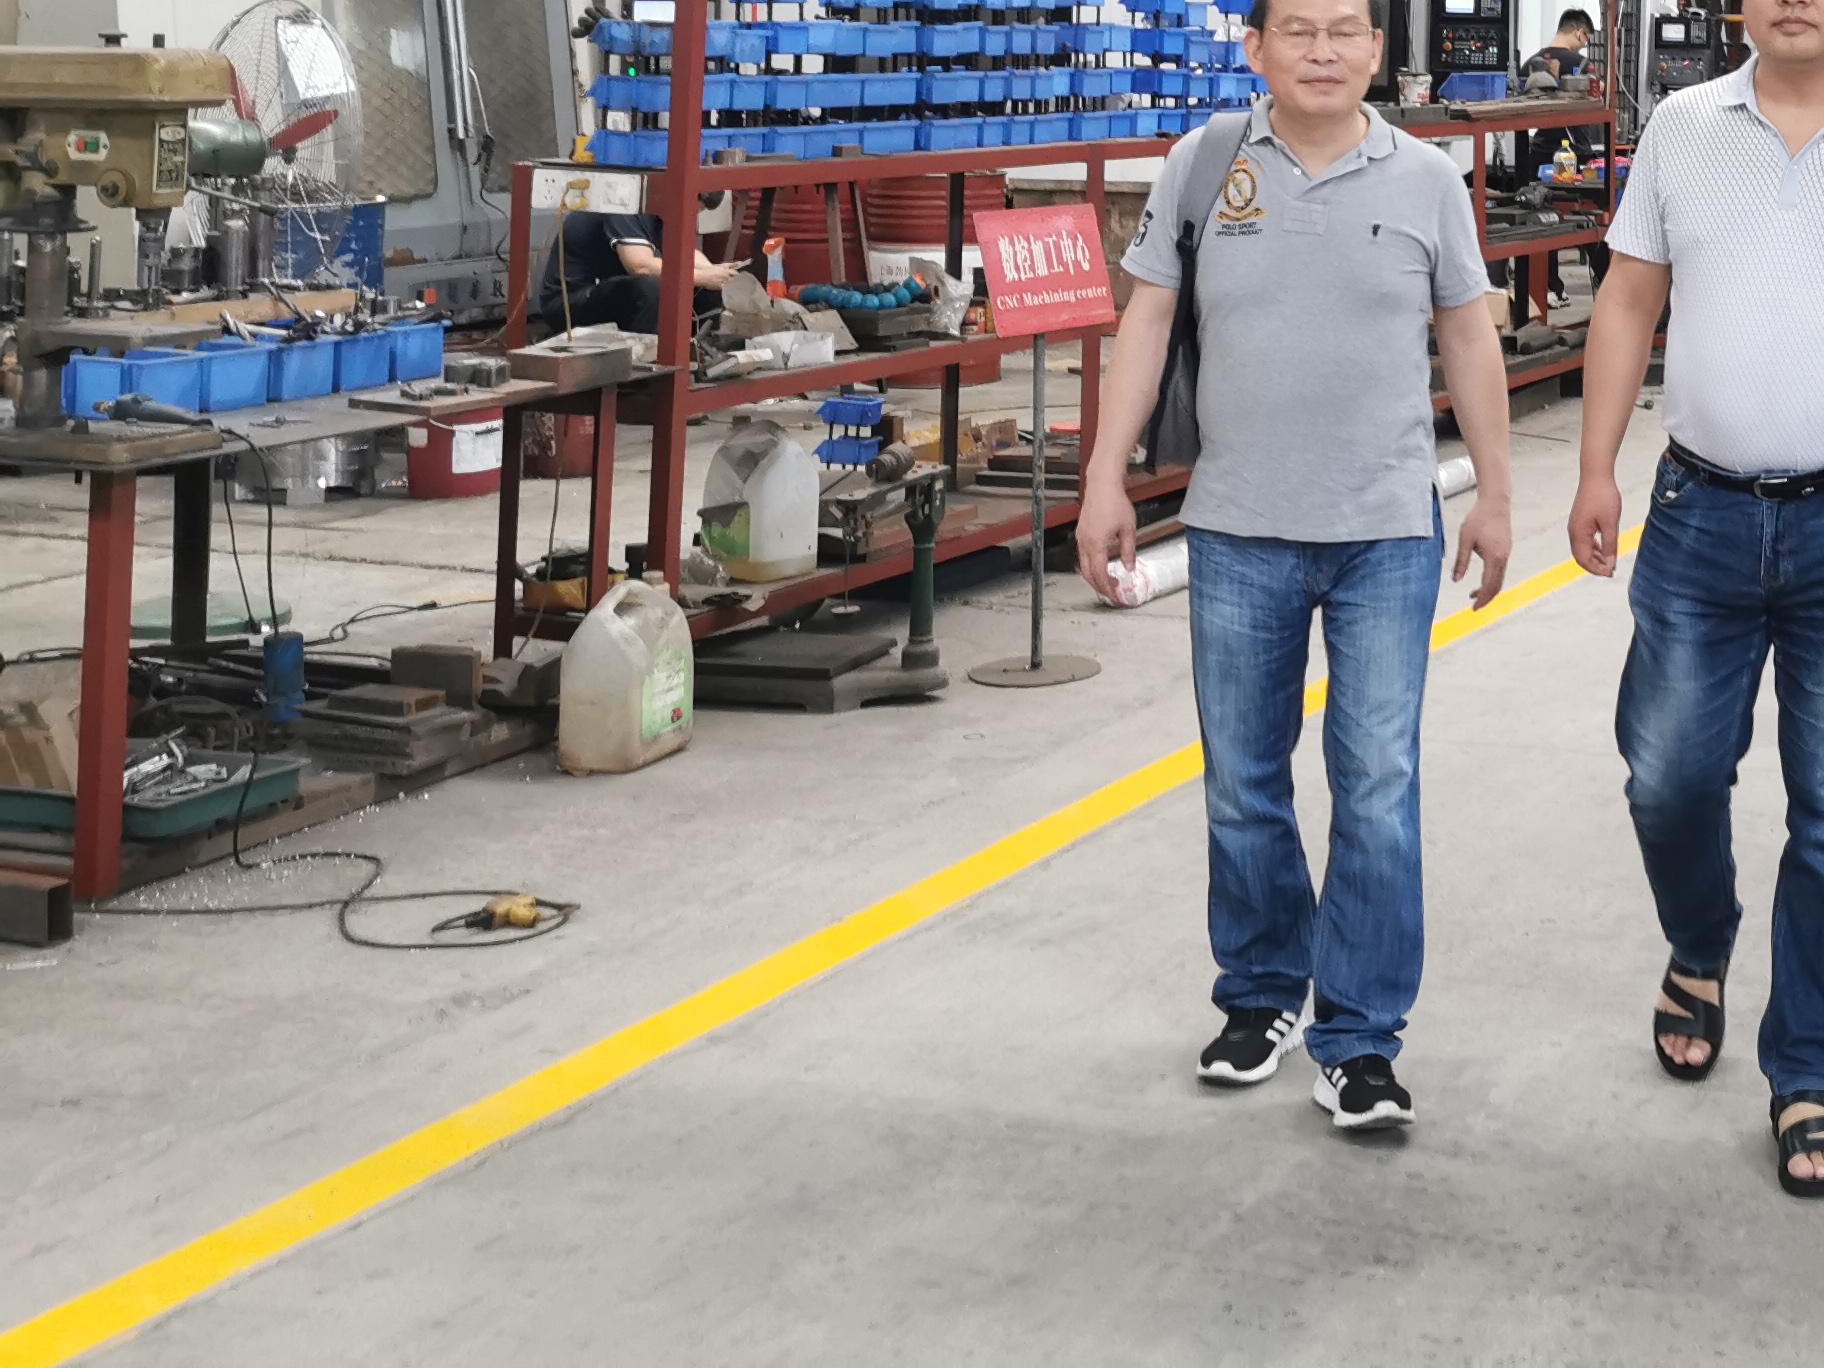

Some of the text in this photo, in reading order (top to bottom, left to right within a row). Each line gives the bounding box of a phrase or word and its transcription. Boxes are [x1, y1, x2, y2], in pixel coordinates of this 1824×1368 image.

[1221, 221, 1257, 231] POLO SPORT
[1238, 228, 1263, 236] PRODUCT
[998, 229, 1091, 284] 数控加工中心
[996, 285, 1109, 311] CNC Machining center
